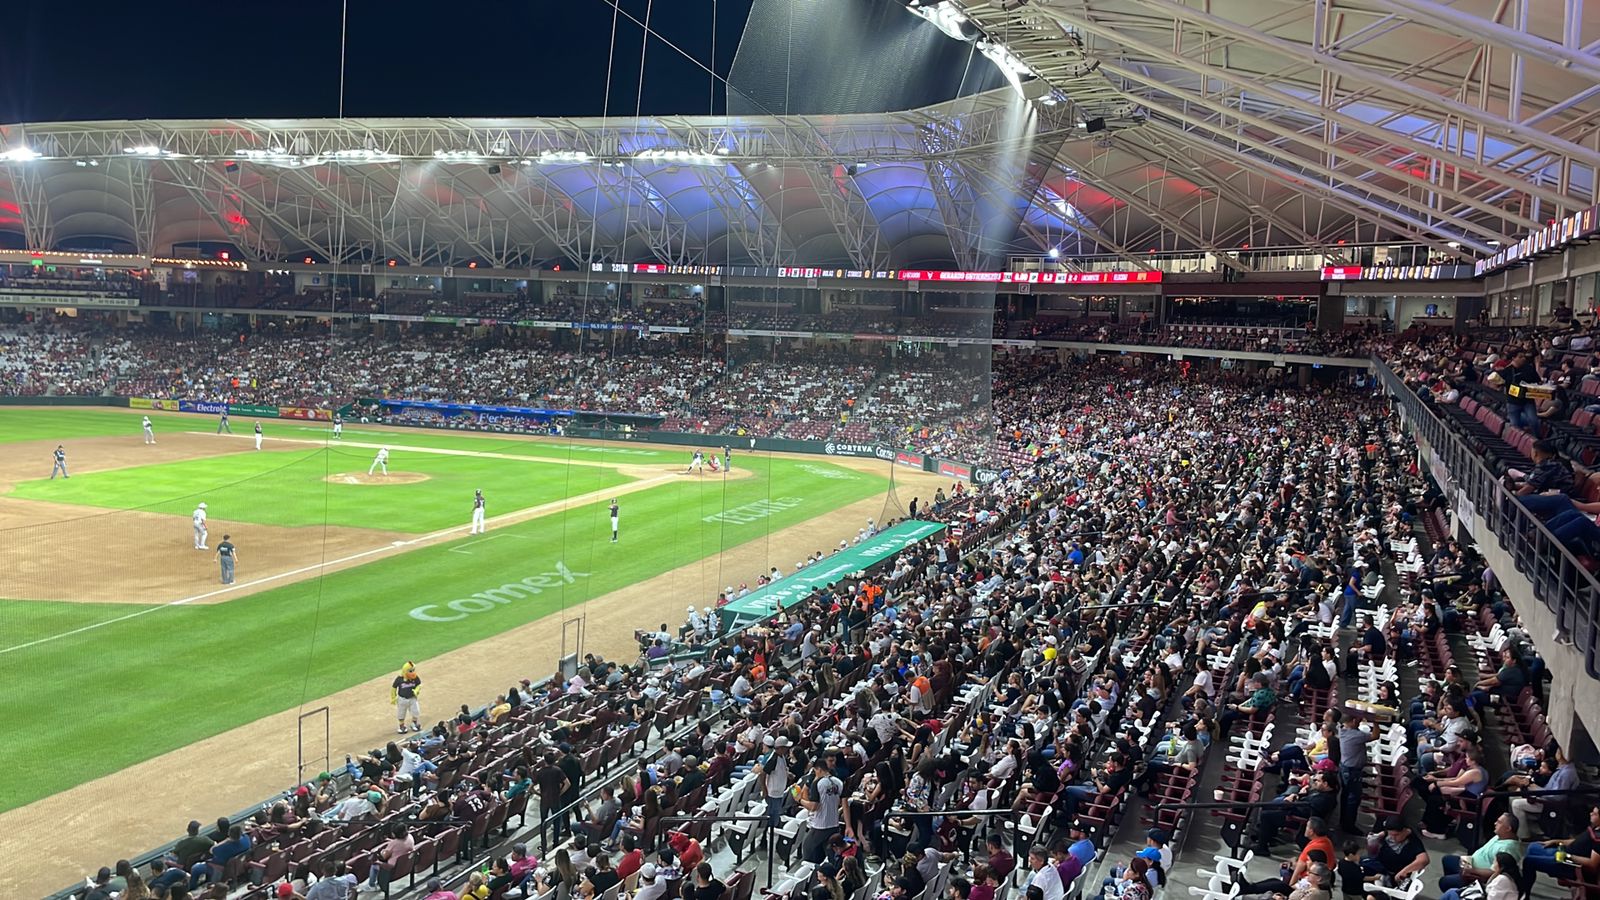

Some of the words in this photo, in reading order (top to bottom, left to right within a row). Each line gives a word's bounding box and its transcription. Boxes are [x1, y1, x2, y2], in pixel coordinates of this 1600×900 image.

[836, 443, 872, 453] CORTEVA
[408, 560, 592, 622] Comex
[468, 797, 484, 812] 13
